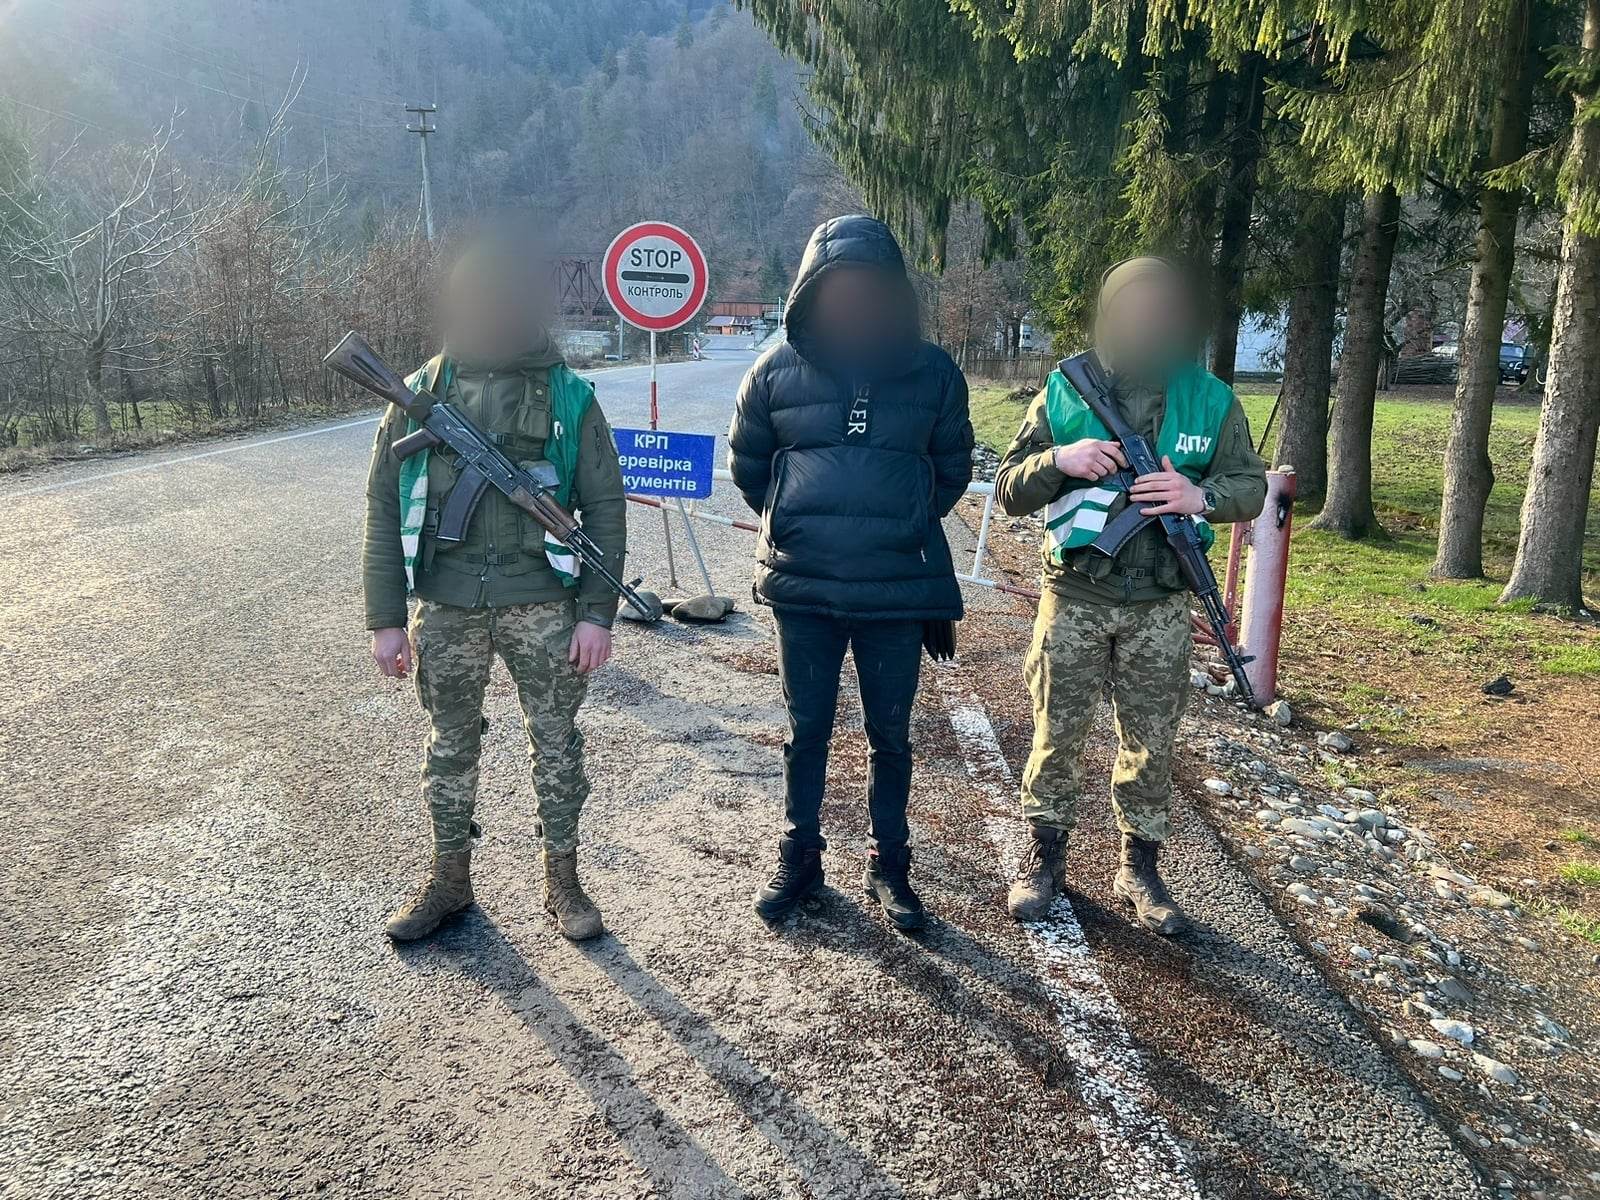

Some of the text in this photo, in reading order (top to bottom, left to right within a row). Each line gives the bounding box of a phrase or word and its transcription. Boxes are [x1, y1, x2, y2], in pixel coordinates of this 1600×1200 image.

[631, 248, 681, 268] STOP
[628, 286, 683, 298] КОНТРОЛЬ
[634, 434, 669, 450] КРП
[618, 454, 692, 472] еревірка
[622, 475, 696, 491] кументів
